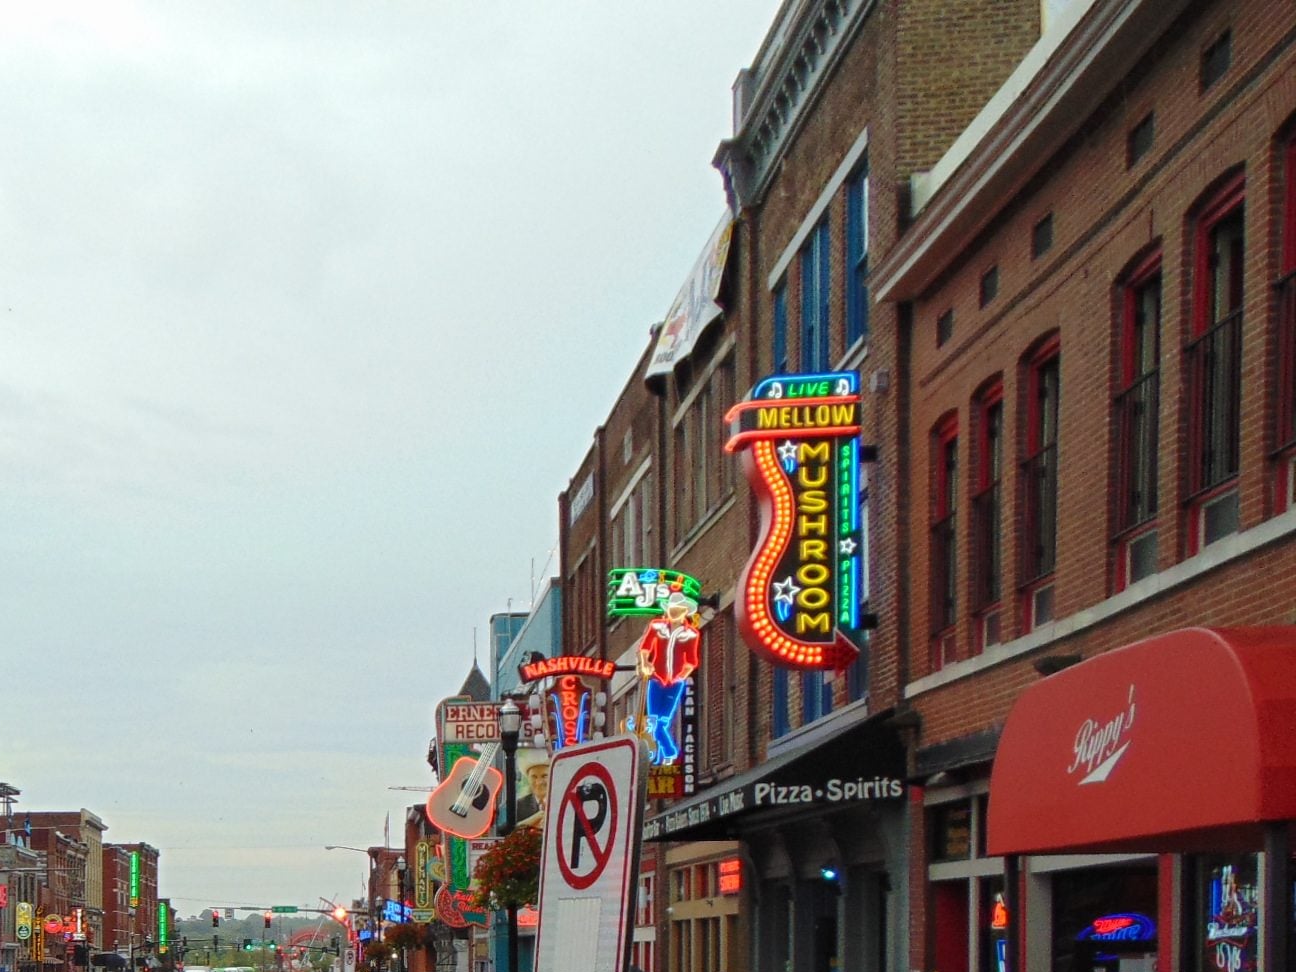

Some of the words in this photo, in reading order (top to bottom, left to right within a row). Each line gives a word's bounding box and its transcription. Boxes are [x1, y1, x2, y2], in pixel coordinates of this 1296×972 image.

[787, 381, 829, 396] LIVE
[756, 403, 855, 428] MELLOW
[839, 445, 850, 532] SPIRITS
[796, 441, 830, 633] MUSHROOM
[839, 559, 851, 623] PIZZA
[524, 656, 615, 678] NASHVILLE
[685, 676, 695, 716] ALAN
[1067, 684, 1136, 773] Rippy's
[685, 724, 695, 793] JACKSON
[754, 782, 813, 805] Pizza
[826, 776, 903, 802] Spirits
